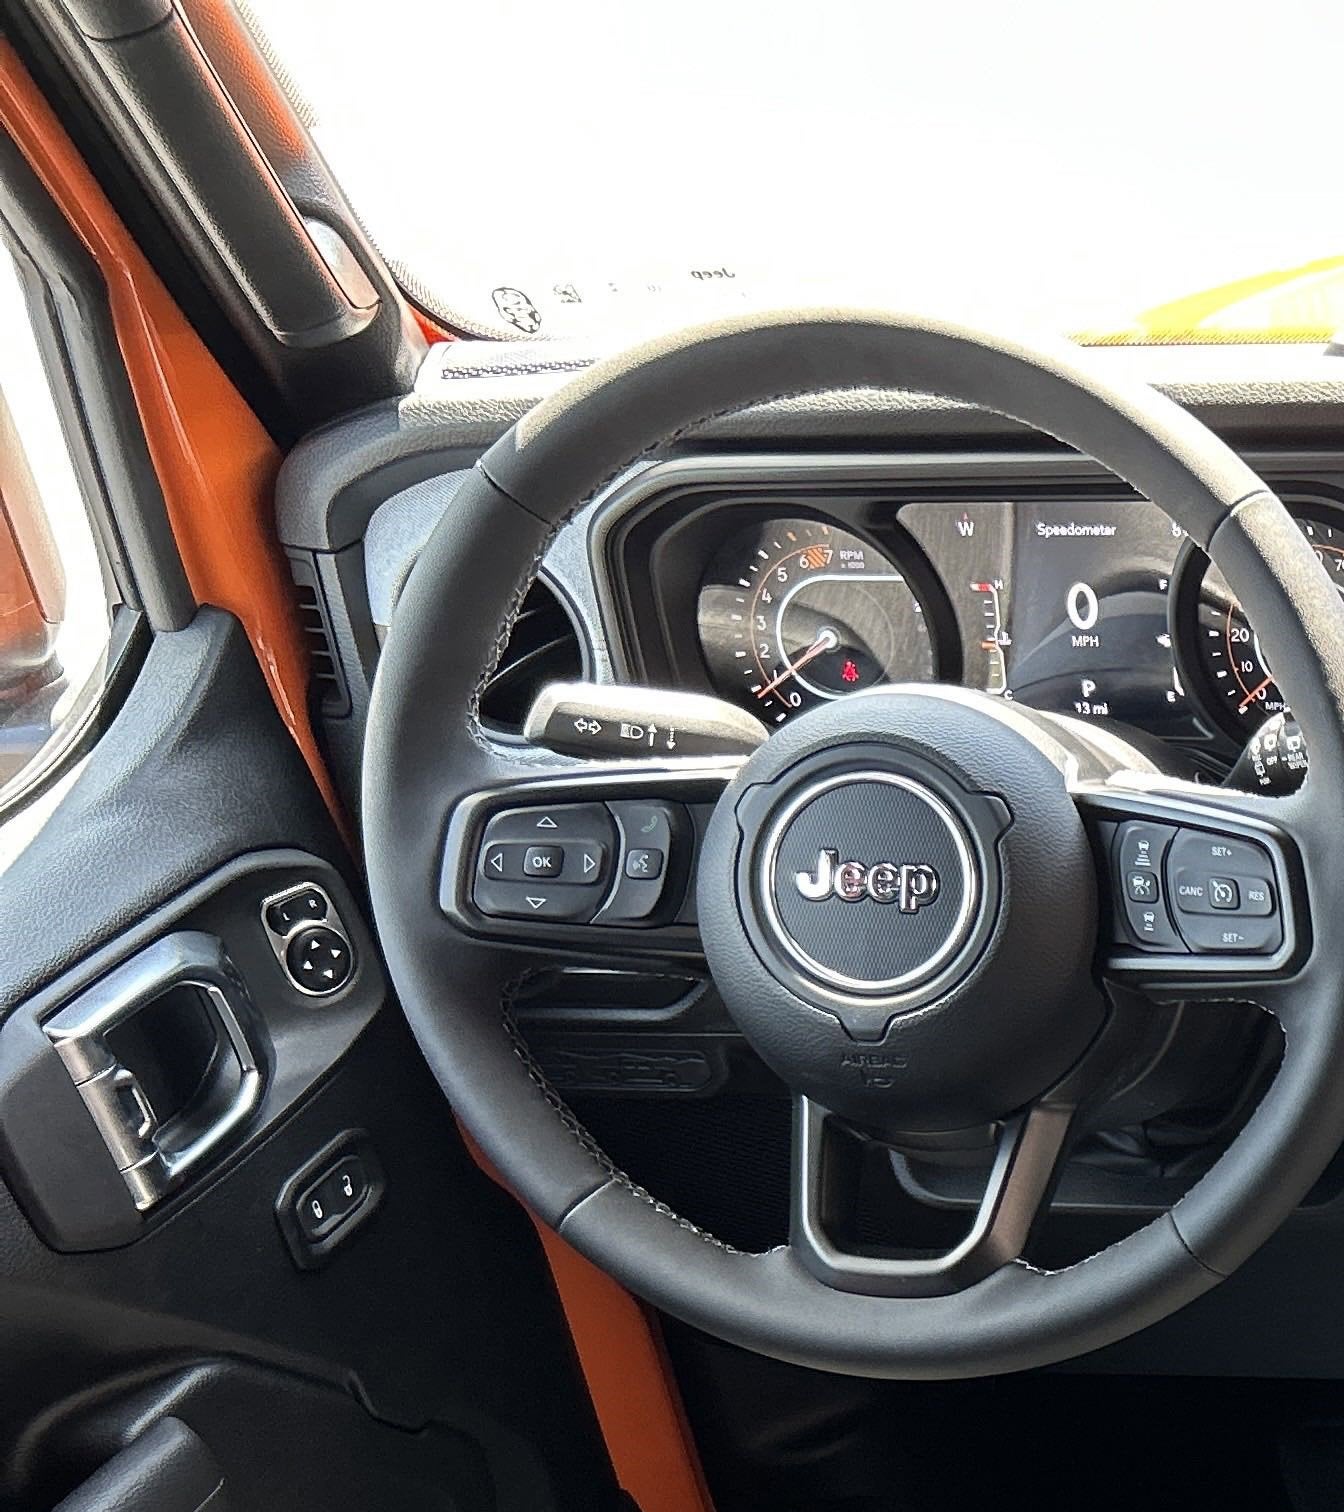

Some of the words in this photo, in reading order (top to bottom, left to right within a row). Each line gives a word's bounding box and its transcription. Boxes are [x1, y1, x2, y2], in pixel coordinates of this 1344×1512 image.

[957, 521, 974, 537] W
[1037, 523, 1117, 538] Speedometer
[799, 554, 809, 569] 6
[825, 550, 833, 565] 7
[839, 550, 864, 561] RPM
[777, 567, 788, 583] 5
[761, 588, 772, 604] 4
[1066, 582, 1099, 631] 0
[756, 616, 767, 630] 3
[1072, 635, 1100, 648] MPH
[1231, 628, 1250, 643] 20
[760, 644, 770, 659] 2
[1241, 661, 1253, 673] 10
[1081, 679, 1097, 698] P
[789, 692, 801, 707] 0
[1075, 702, 1090, 714] 13
[1092, 703, 1109, 715] mi
[532, 856, 551, 868] OK
[795, 848, 940, 915] Jeep
[1179, 886, 1203, 897] CANC
[1248, 890, 1265, 901] RES
[308, 899, 318, 909] R
